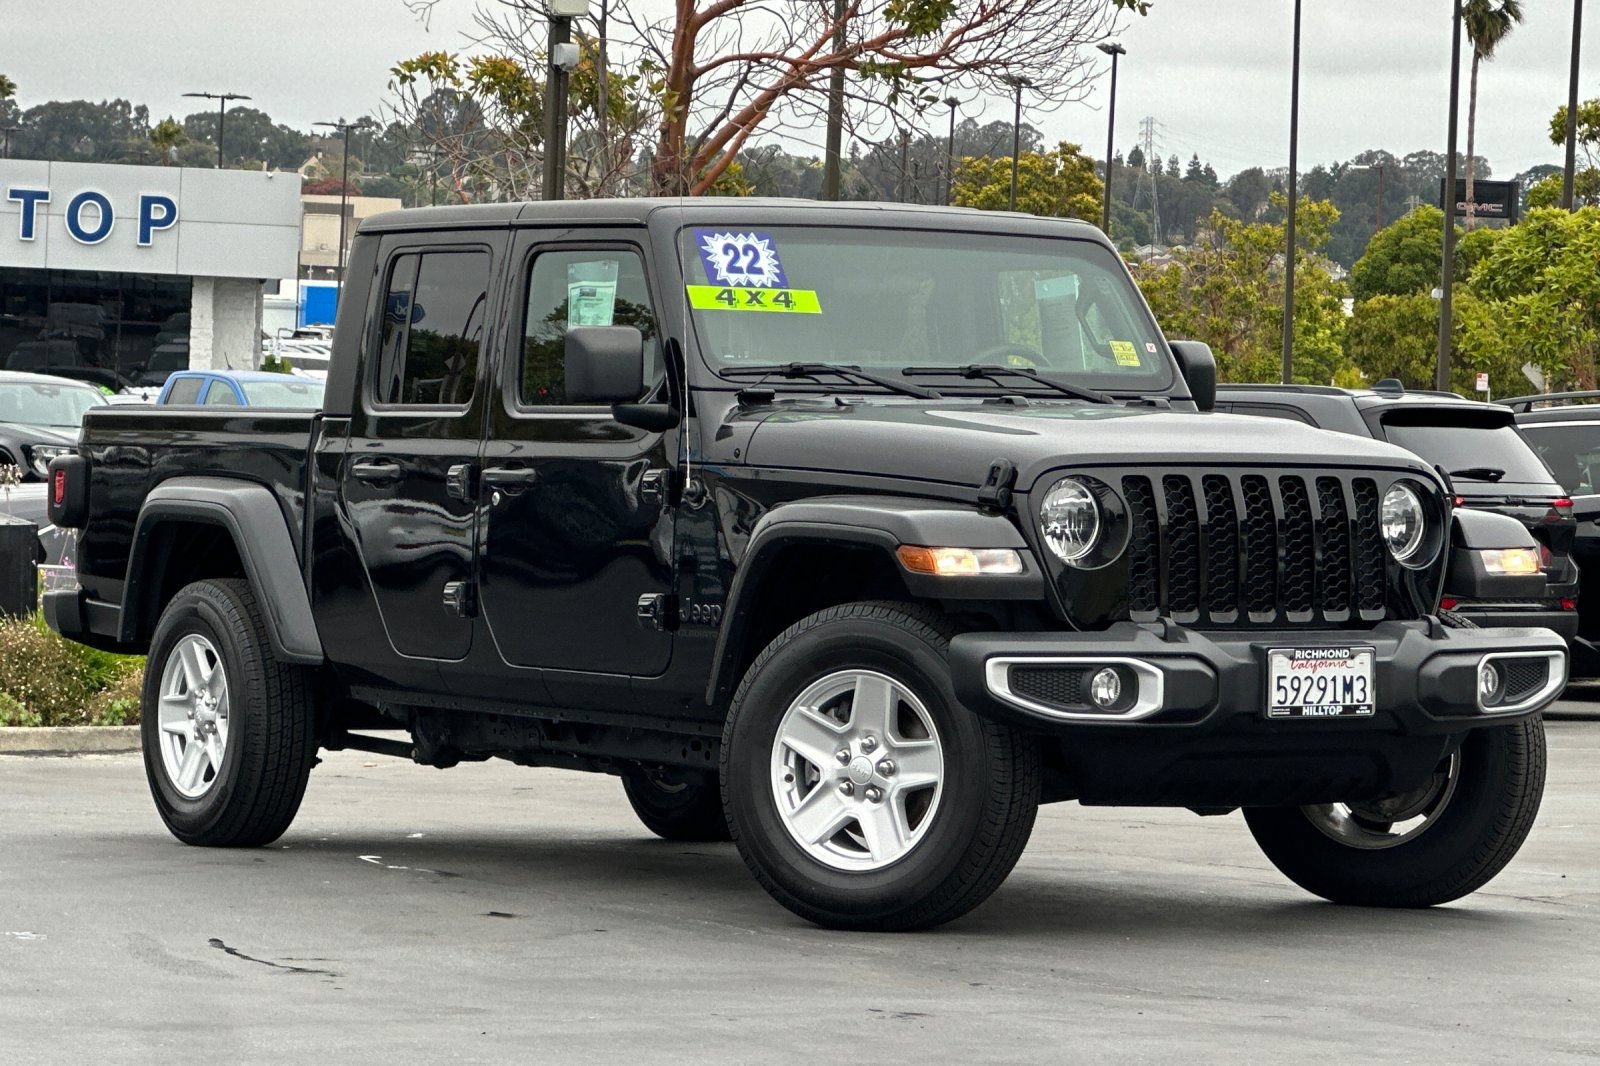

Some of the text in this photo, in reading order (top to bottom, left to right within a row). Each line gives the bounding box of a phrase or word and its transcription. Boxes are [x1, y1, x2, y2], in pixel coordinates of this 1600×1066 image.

[7, 186, 179, 247] TOP
[722, 243, 765, 276] 22
[678, 597, 722, 627] Jeep
[1290, 659, 1355, 673] California
[1294, 649, 1350, 660] RICHMOND
[1276, 675, 1367, 705] 59291M3
[1302, 705, 1344, 716] HILLTOP
